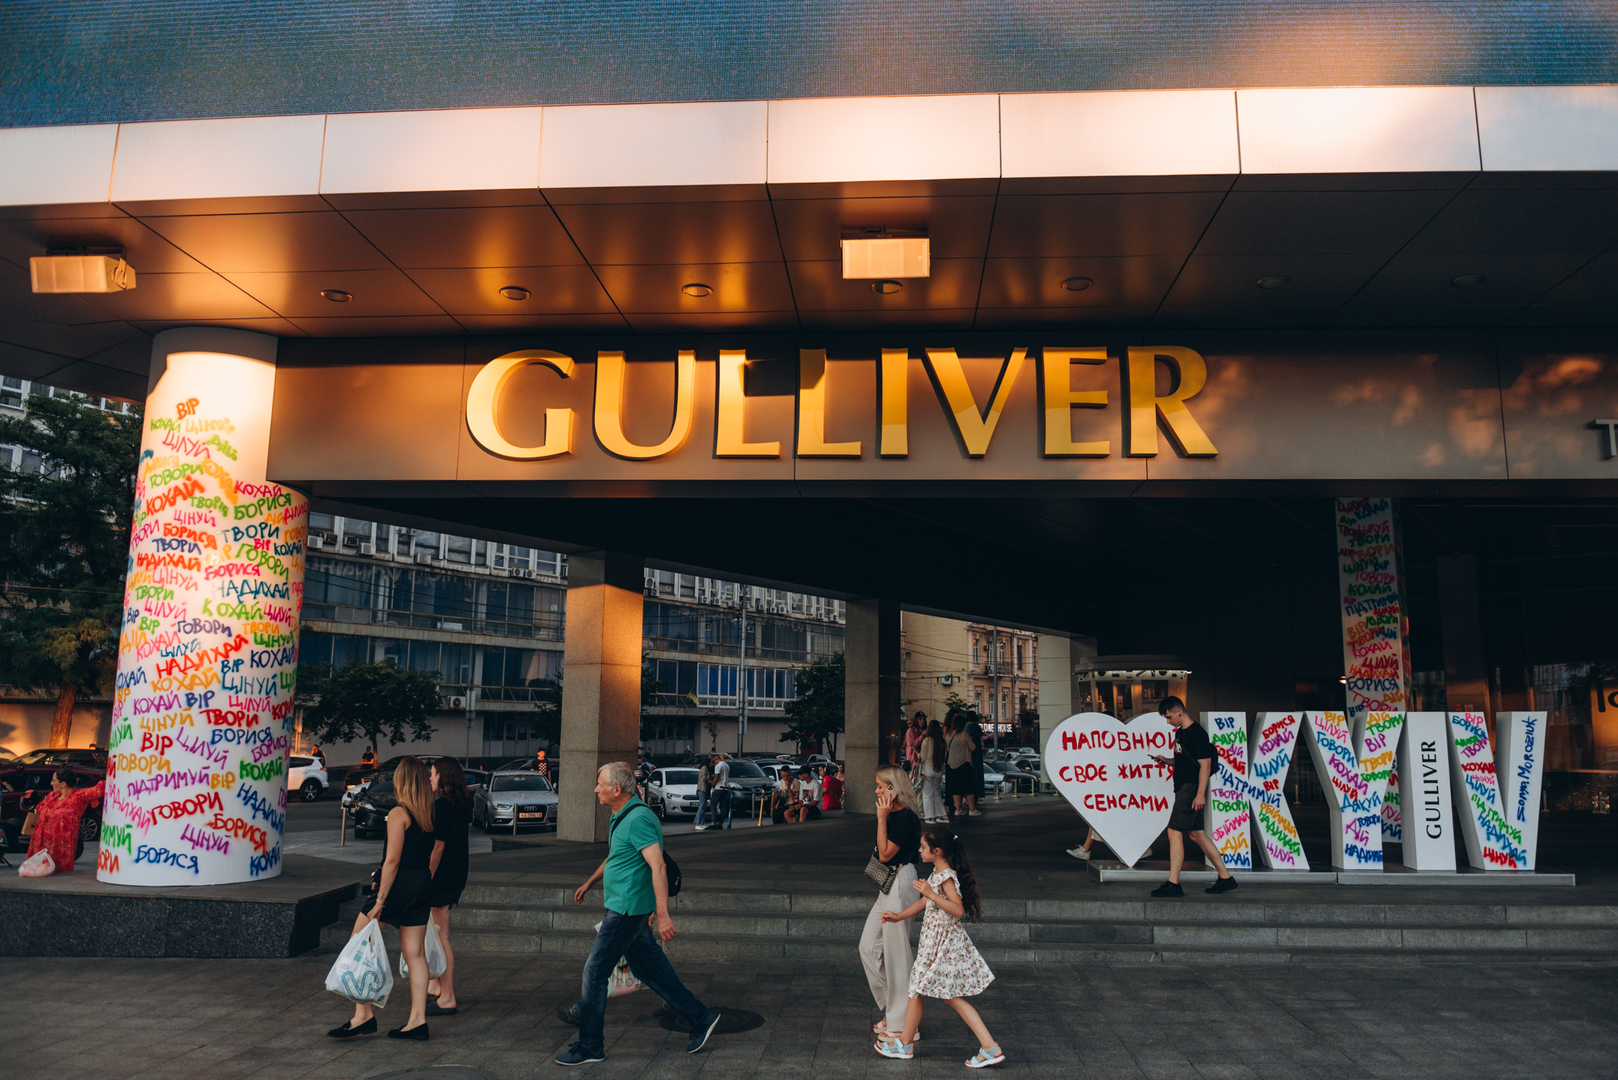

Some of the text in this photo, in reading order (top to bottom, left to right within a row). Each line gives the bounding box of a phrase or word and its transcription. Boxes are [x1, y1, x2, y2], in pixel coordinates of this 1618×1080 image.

[176, 398, 200, 420] ВІР
[466, 347, 1219, 459] GULLIVER
[150, 417, 181, 433] КОХАЙ
[150, 463, 204, 489] ГОВОРИ
[146, 475, 206, 517] КОХАЙ
[234, 480, 283, 498] КОХАЙ
[233, 493, 292, 520] БОРИСЯ
[173, 509, 216, 527] ЦІНУЙ
[163, 522, 218, 550] БОРИСЯ
[217, 522, 280, 543] ТВОРИ
[152, 538, 202, 555] ТВОРИ
[254, 538, 271, 551] ВІР
[136, 552, 202, 573] НАДИХАЙ
[204, 563, 261, 581] БОРИСЯ
[235, 543, 289, 582] ГОВОРИ
[135, 584, 174, 601] ТВОРИ
[211, 579, 290, 604] НАДИХАЙ
[144, 596, 187, 621] ЦІЛУЙ
[201, 598, 263, 621] КОХАЙ
[140, 616, 160, 635] ВІР
[177, 618, 232, 637] ГОВОРИ
[243, 621, 279, 635] ТВОРИ
[136, 623, 182, 662] КОХАЙ
[156, 634, 249, 678] НАДИХАЙ
[220, 658, 244, 674] ВІР
[150, 667, 221, 692] КОХАЙ
[221, 672, 278, 697] ЦІНУЙ
[1346, 675, 1399, 691] БОРИСЯ
[133, 690, 182, 715] КОХАЙ
[185, 690, 215, 709] ВІР
[228, 695, 272, 713] ЦІЛУЙ
[139, 707, 195, 732] ЦІНУЙ
[198, 708, 259, 728] ТВОРИ
[1215, 716, 1235, 730] ВІР
[1261, 714, 1295, 740] БОРИСЯ
[1366, 713, 1404, 736] ТВОРИ
[1465, 712, 1484, 728] ВІР
[140, 732, 173, 756] ВІР
[210, 727, 272, 745] БОРИСЯ
[1365, 733, 1386, 752] ВІР
[1316, 731, 1355, 768] ГОВОРИ
[117, 753, 171, 775] ГОВОРИ
[239, 756, 283, 782] КОХАЙ
[1059, 763, 1108, 783] СВОЄ
[127, 766, 211, 800] ПІДТРИМУЙ
[210, 771, 236, 790] ВІР
[1263, 779, 1279, 791] ВІР
[1421, 741, 1442, 839] GULLIVER
[1083, 793, 1169, 812] СЕНСАМИ
[1211, 788, 1244, 800] ТВОРИ
[150, 792, 224, 826] ГОВОРИ
[1212, 800, 1248, 812] ГОВОРИ
[180, 823, 232, 855] ЦІНУЙ
[208, 813, 268, 855] БОРИСЯ
[134, 845, 200, 874] БОРИСЯ
